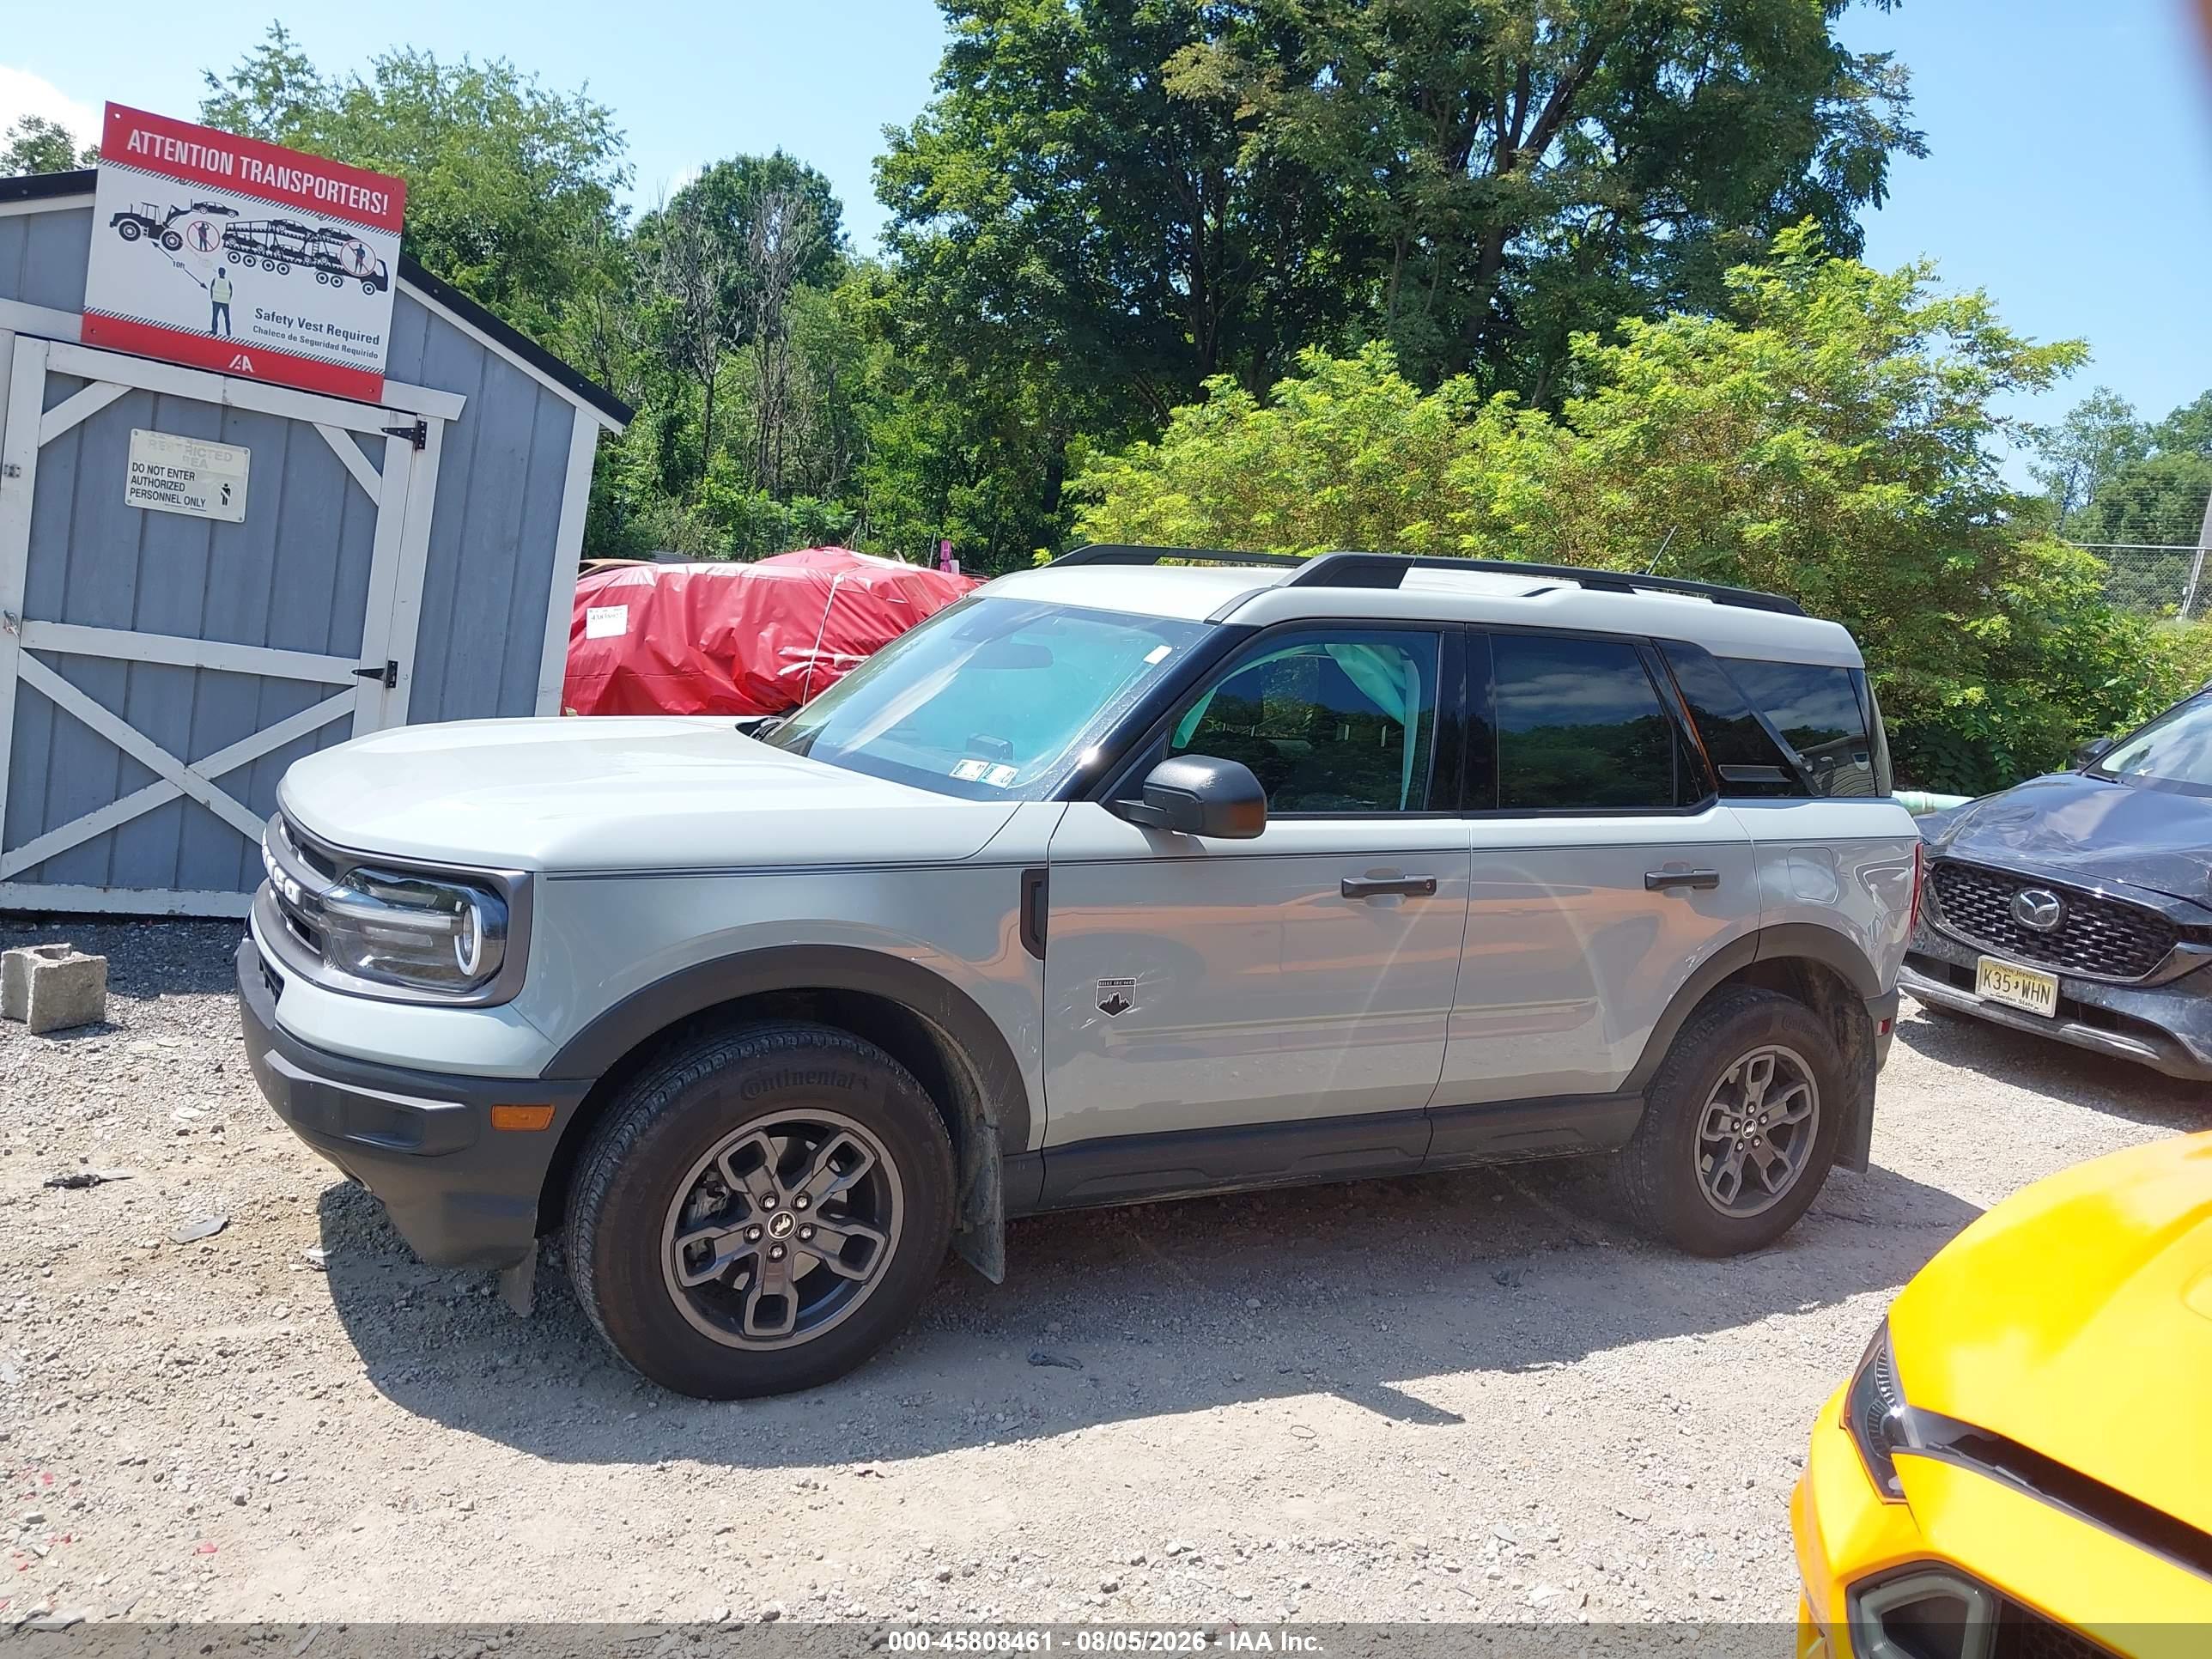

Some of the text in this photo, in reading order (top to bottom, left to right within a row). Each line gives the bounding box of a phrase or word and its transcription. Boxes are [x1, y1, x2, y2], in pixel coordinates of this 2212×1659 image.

[127, 129, 389, 216] ATTENTION TRANSPORTERS!
[254, 307, 380, 345] Safety Vest Required
[252, 325, 286, 339] Chaleco
[288, 332, 297, 342] de
[300, 335, 339, 351] Seguridad
[131, 462, 196, 481] DO NOT ENTER
[131, 475, 185, 492] AUTHORIZED
[130, 488, 182, 504] PERSONNEL
[184, 495, 206, 507] ONLY
[1999, 965, 2037, 981] New Jersey
[1984, 968, 2051, 1006] K35 WHN
[2019, 999, 2034, 1008] State
